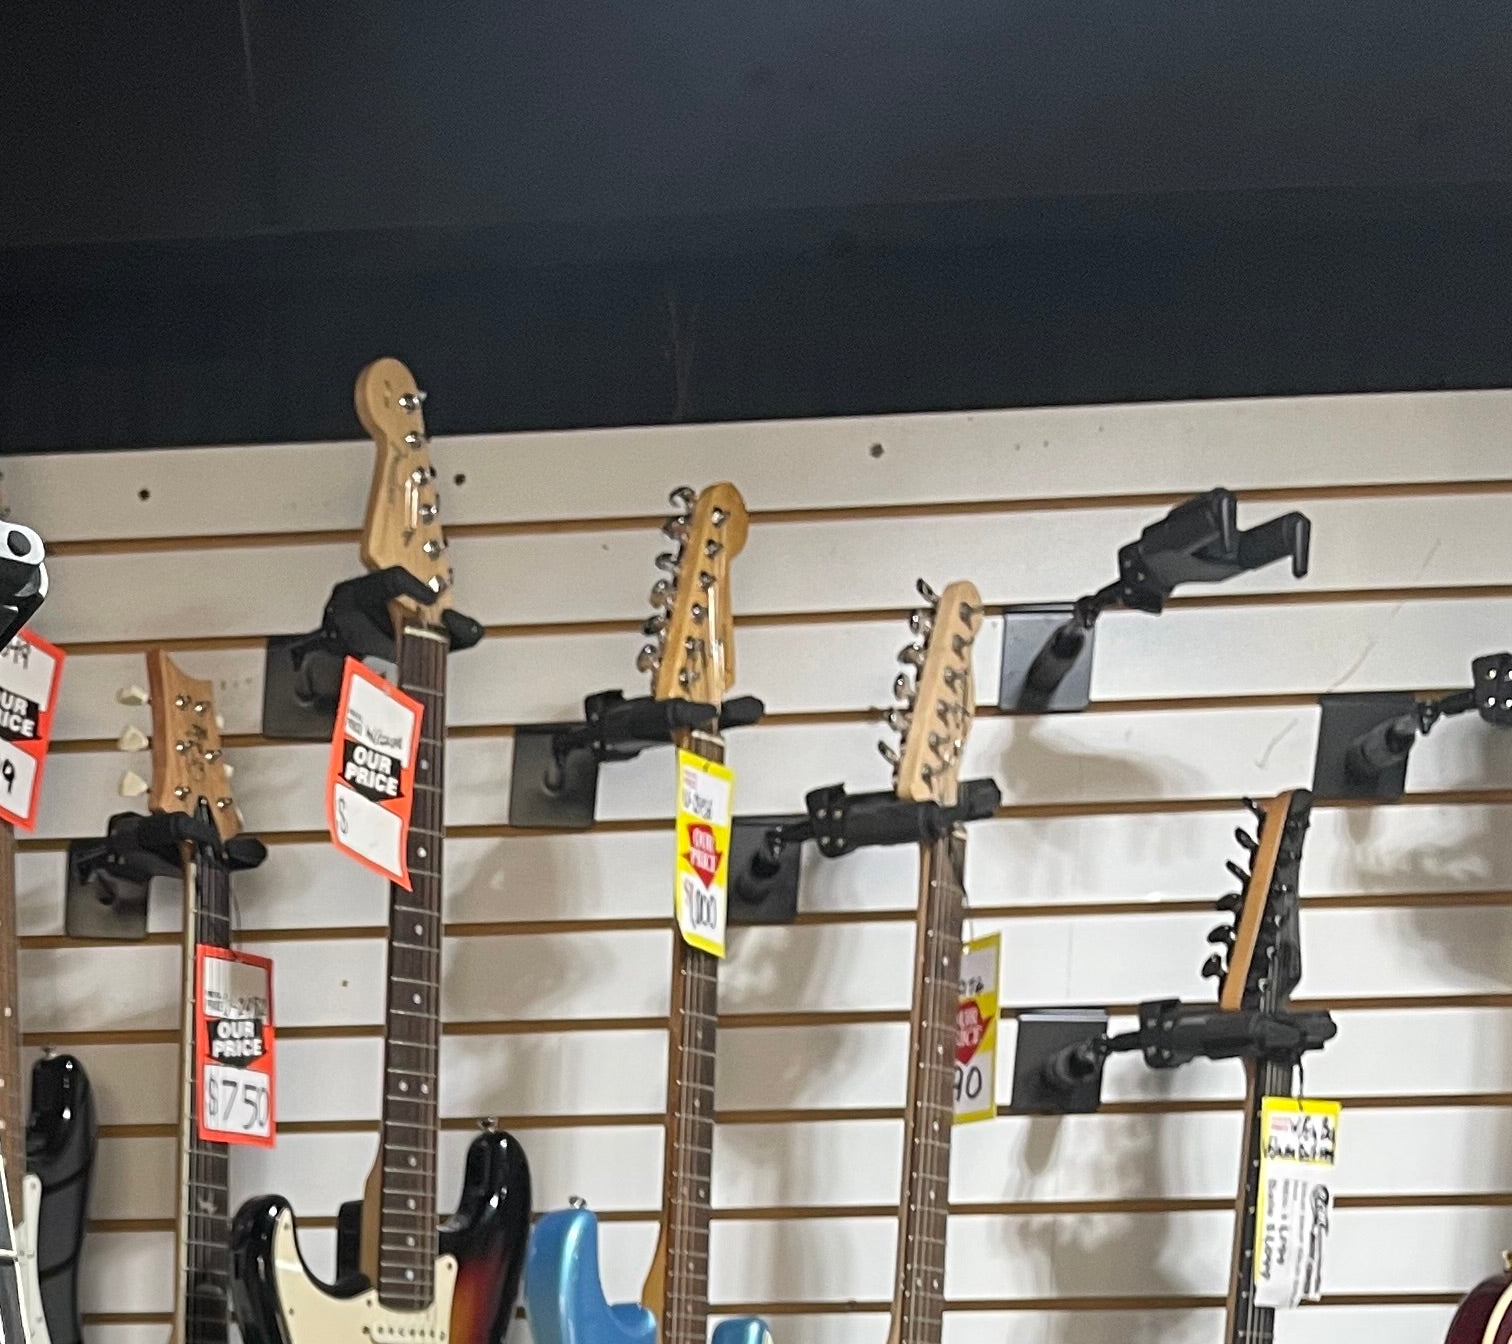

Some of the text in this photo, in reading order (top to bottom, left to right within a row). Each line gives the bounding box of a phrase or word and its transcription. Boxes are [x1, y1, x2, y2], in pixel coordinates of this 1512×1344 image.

[353, 746, 393, 773] OUR
[344, 761, 399, 797] PRICE
[692, 827, 715, 851] OUR
[216, 1020, 255, 1041] OUR
[211, 1038, 263, 1059] PRICE
[208, 1070, 269, 1130] $750
